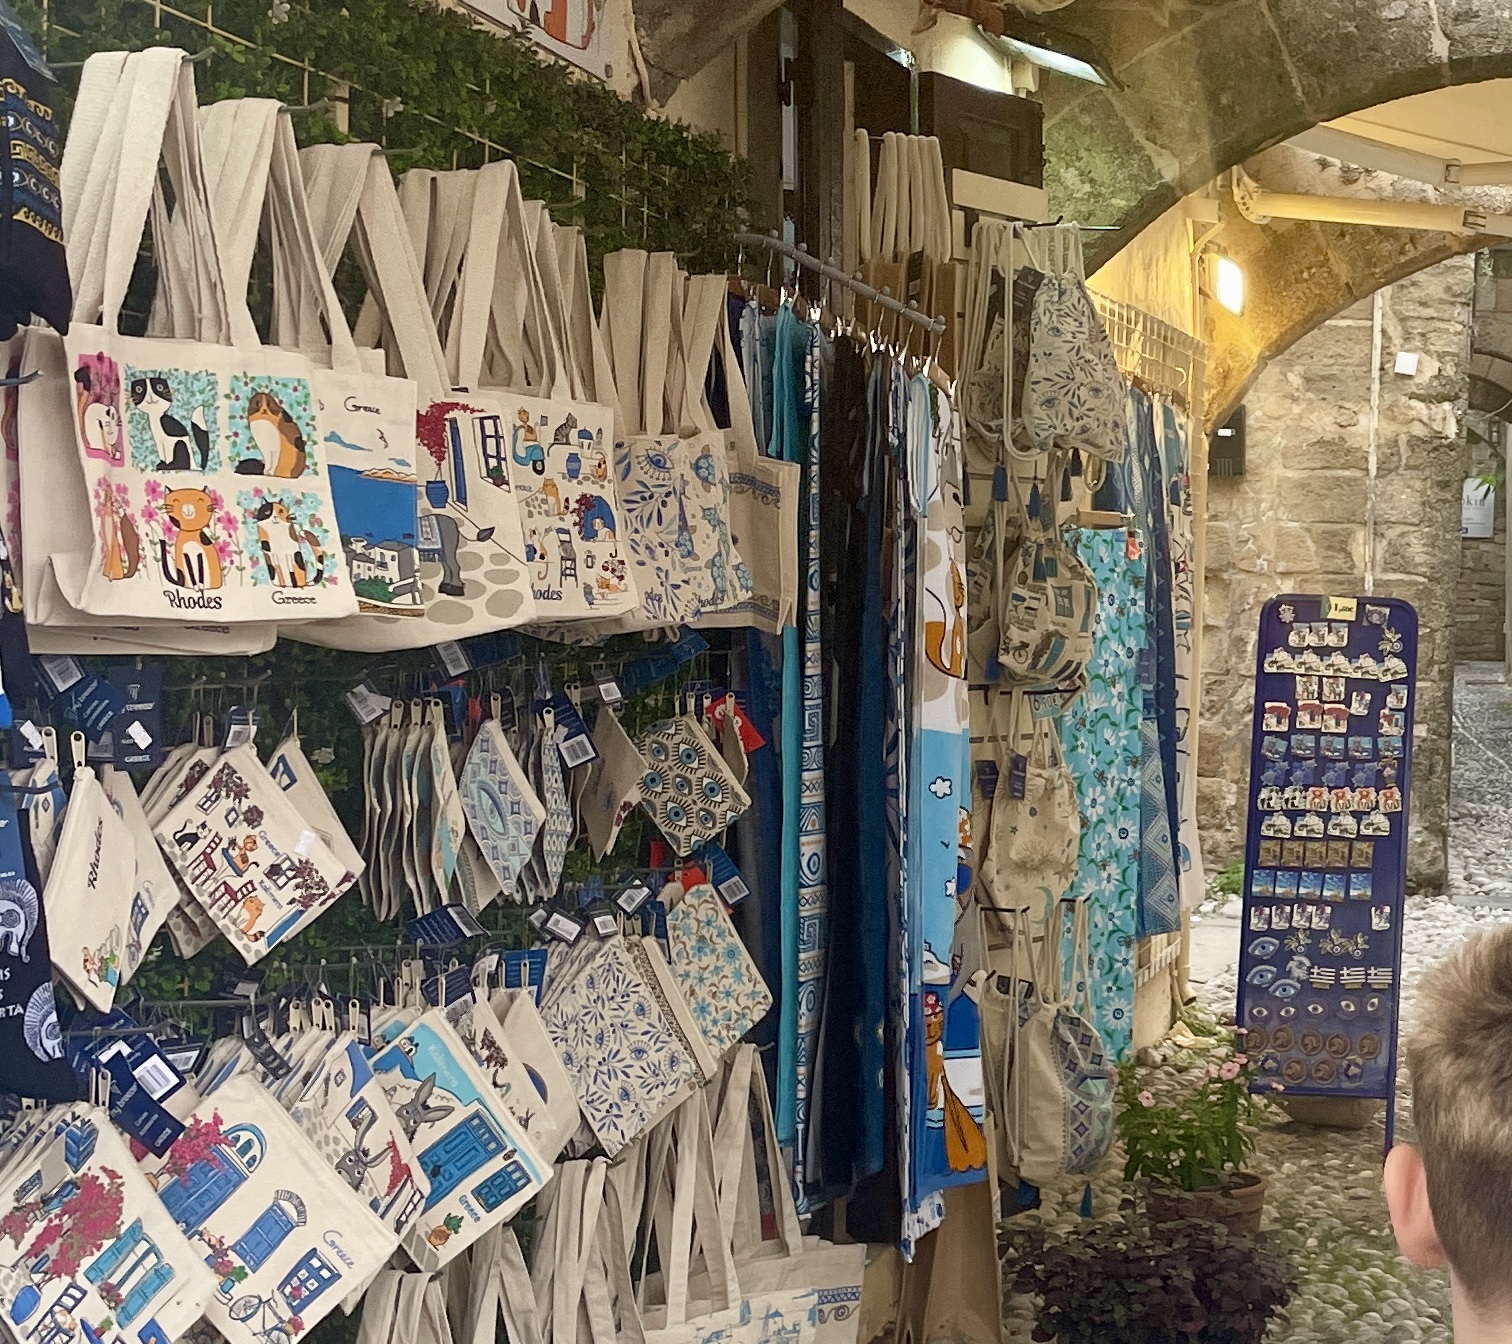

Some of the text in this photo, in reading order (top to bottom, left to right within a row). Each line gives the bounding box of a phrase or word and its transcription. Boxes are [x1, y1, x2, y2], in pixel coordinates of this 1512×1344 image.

[163, 589, 223, 610] Rhodes
[271, 590, 318, 605] Greece
[459, 1194, 481, 1223] Greece
[323, 1229, 355, 1270] Greece
